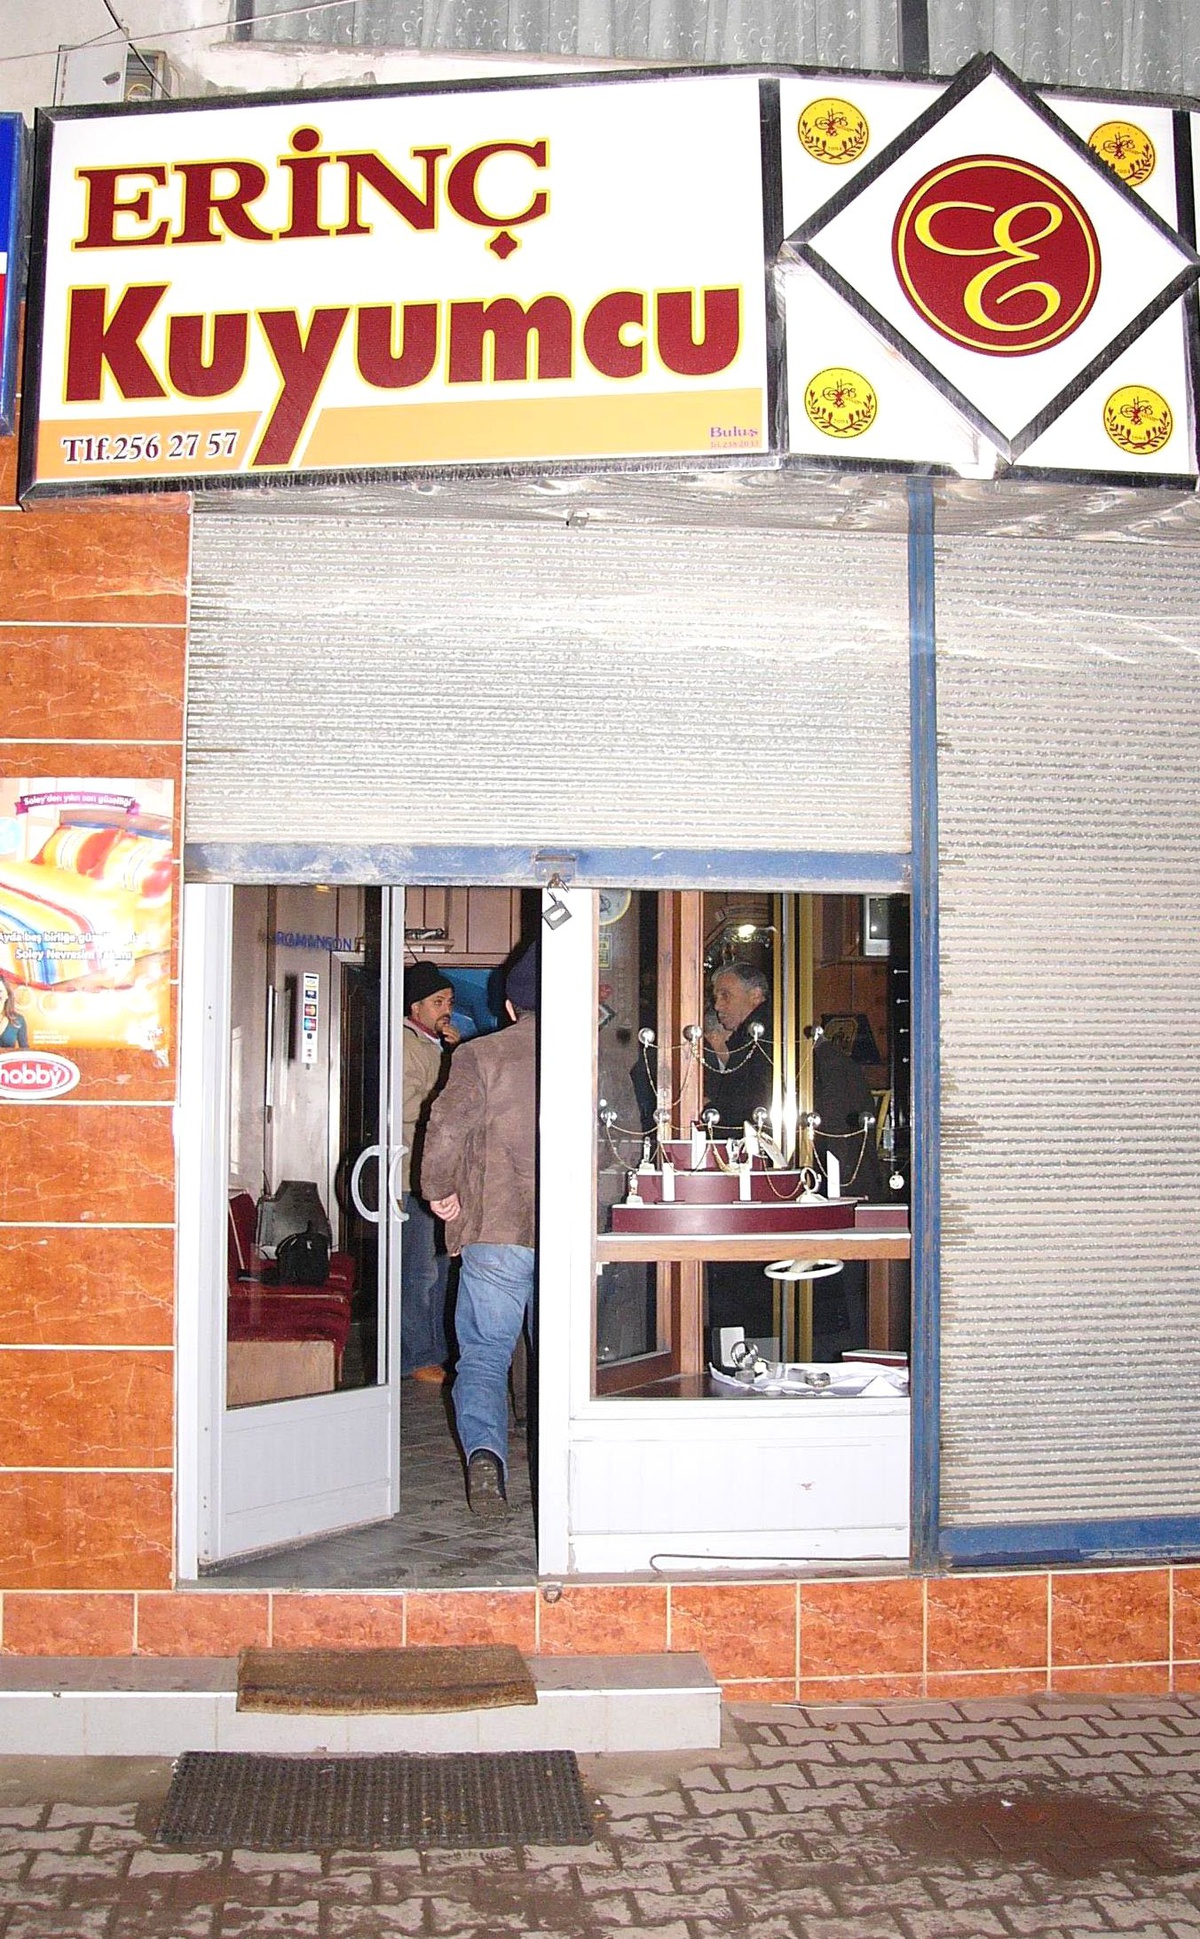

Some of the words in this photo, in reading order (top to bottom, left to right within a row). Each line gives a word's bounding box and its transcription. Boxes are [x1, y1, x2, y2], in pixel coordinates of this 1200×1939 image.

[72, 125, 550, 260] ERİNÇ
[63, 281, 743, 468] Kuyumcu
[168, 434, 199, 457] 27
[207, 431, 238, 456] 57
[16, 948, 44, 961] Soley
